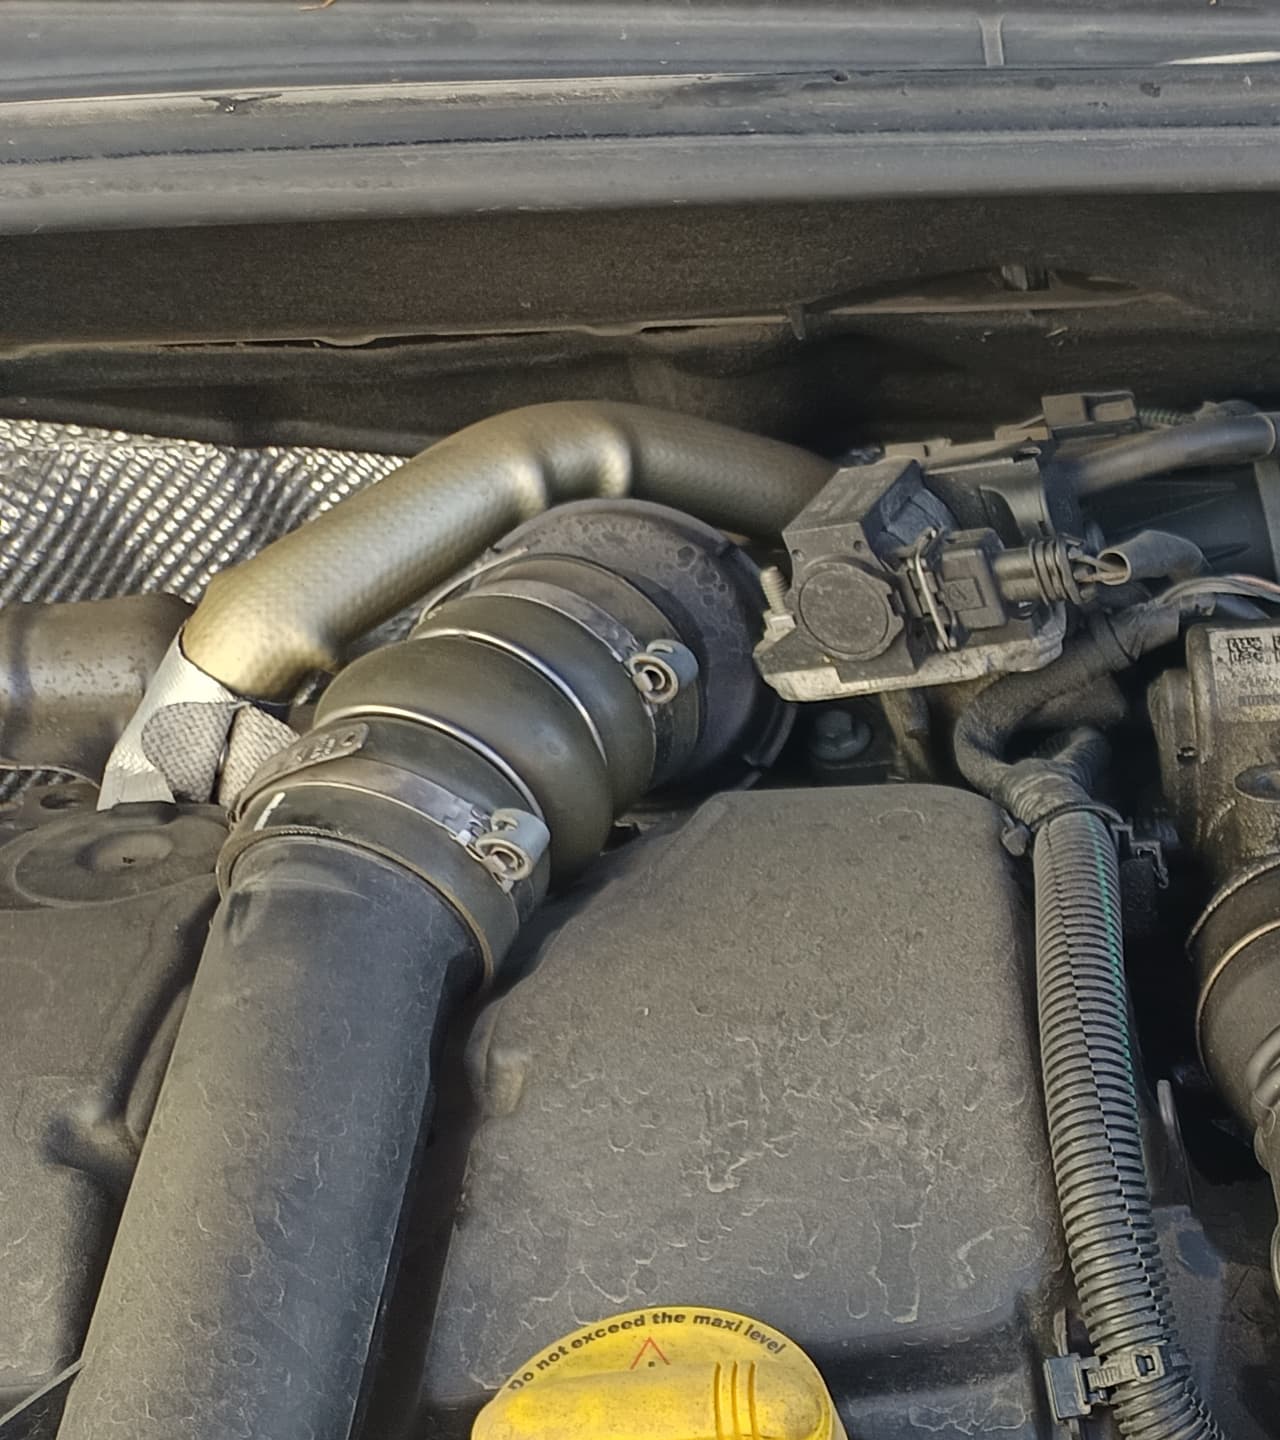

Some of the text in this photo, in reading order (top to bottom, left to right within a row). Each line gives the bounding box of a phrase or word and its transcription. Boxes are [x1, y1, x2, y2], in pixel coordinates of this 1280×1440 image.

[536, 1345, 570, 1371] not
[571, 1313, 646, 1350] exceed
[652, 1311, 686, 1325] the
[692, 1313, 742, 1333] maxi
[744, 1324, 786, 1355] level
